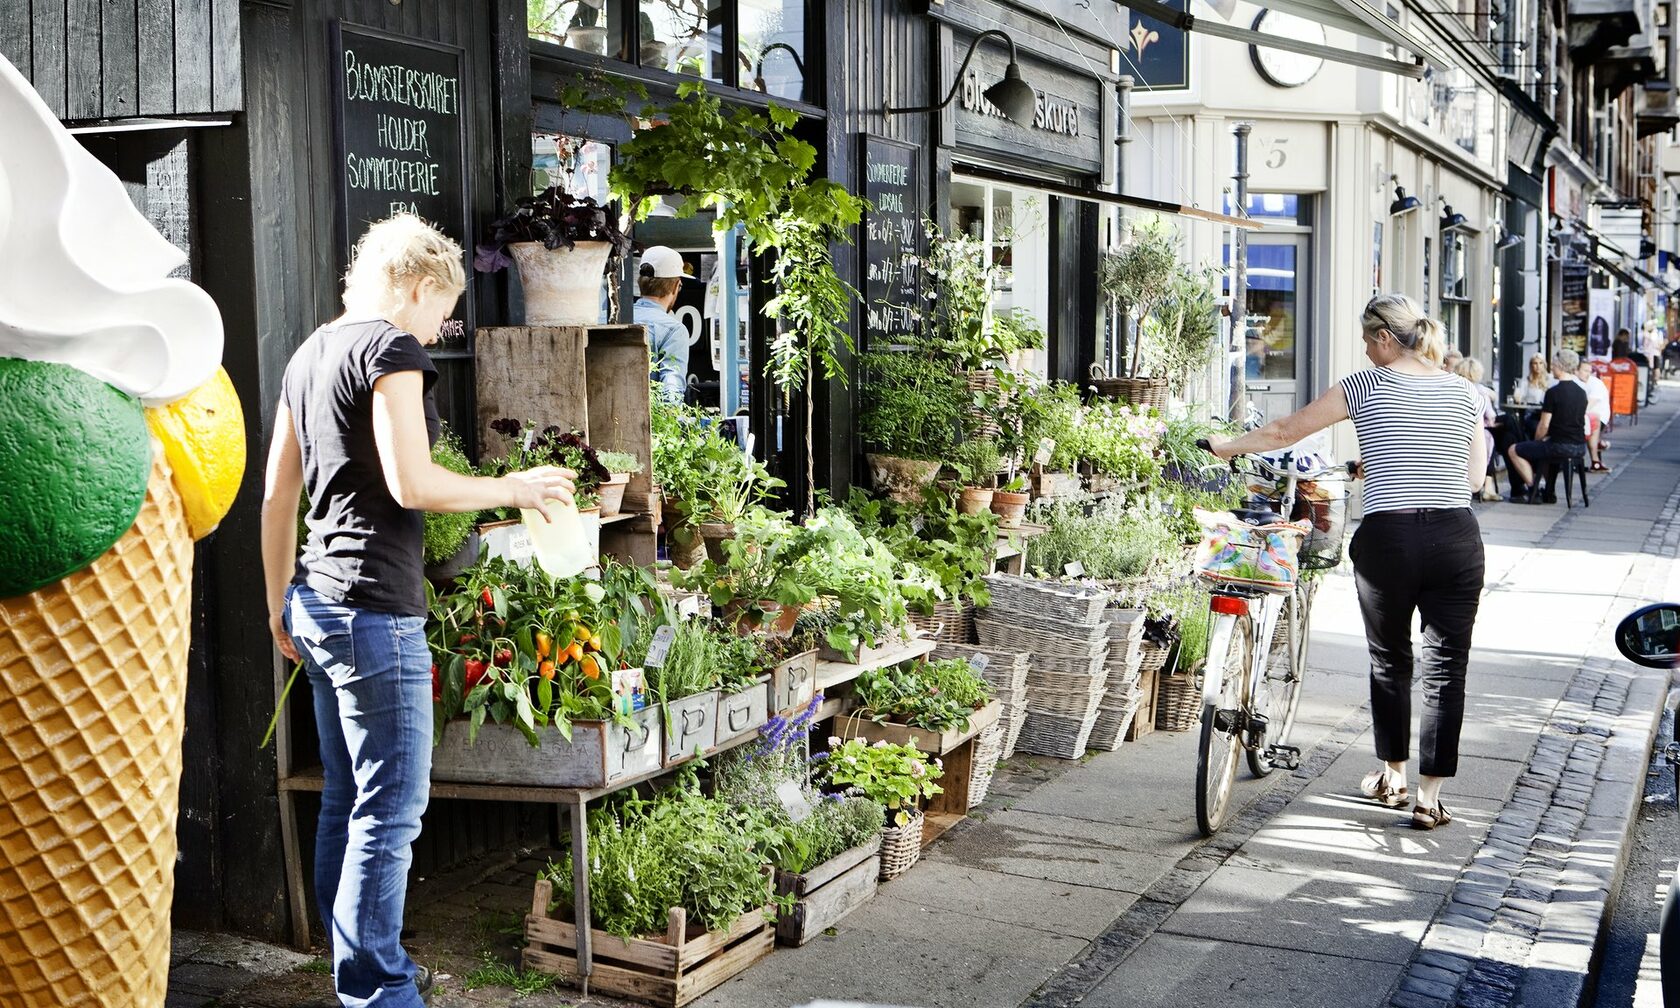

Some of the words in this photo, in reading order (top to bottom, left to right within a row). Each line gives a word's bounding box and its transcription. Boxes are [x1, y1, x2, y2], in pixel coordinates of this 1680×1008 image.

[345, 49, 458, 115] BLOMSTERSKURET
[377, 113, 431, 159] HOLDER
[347, 152, 440, 196] SOMMERFERIE
[879, 192, 904, 214] UDSALG
